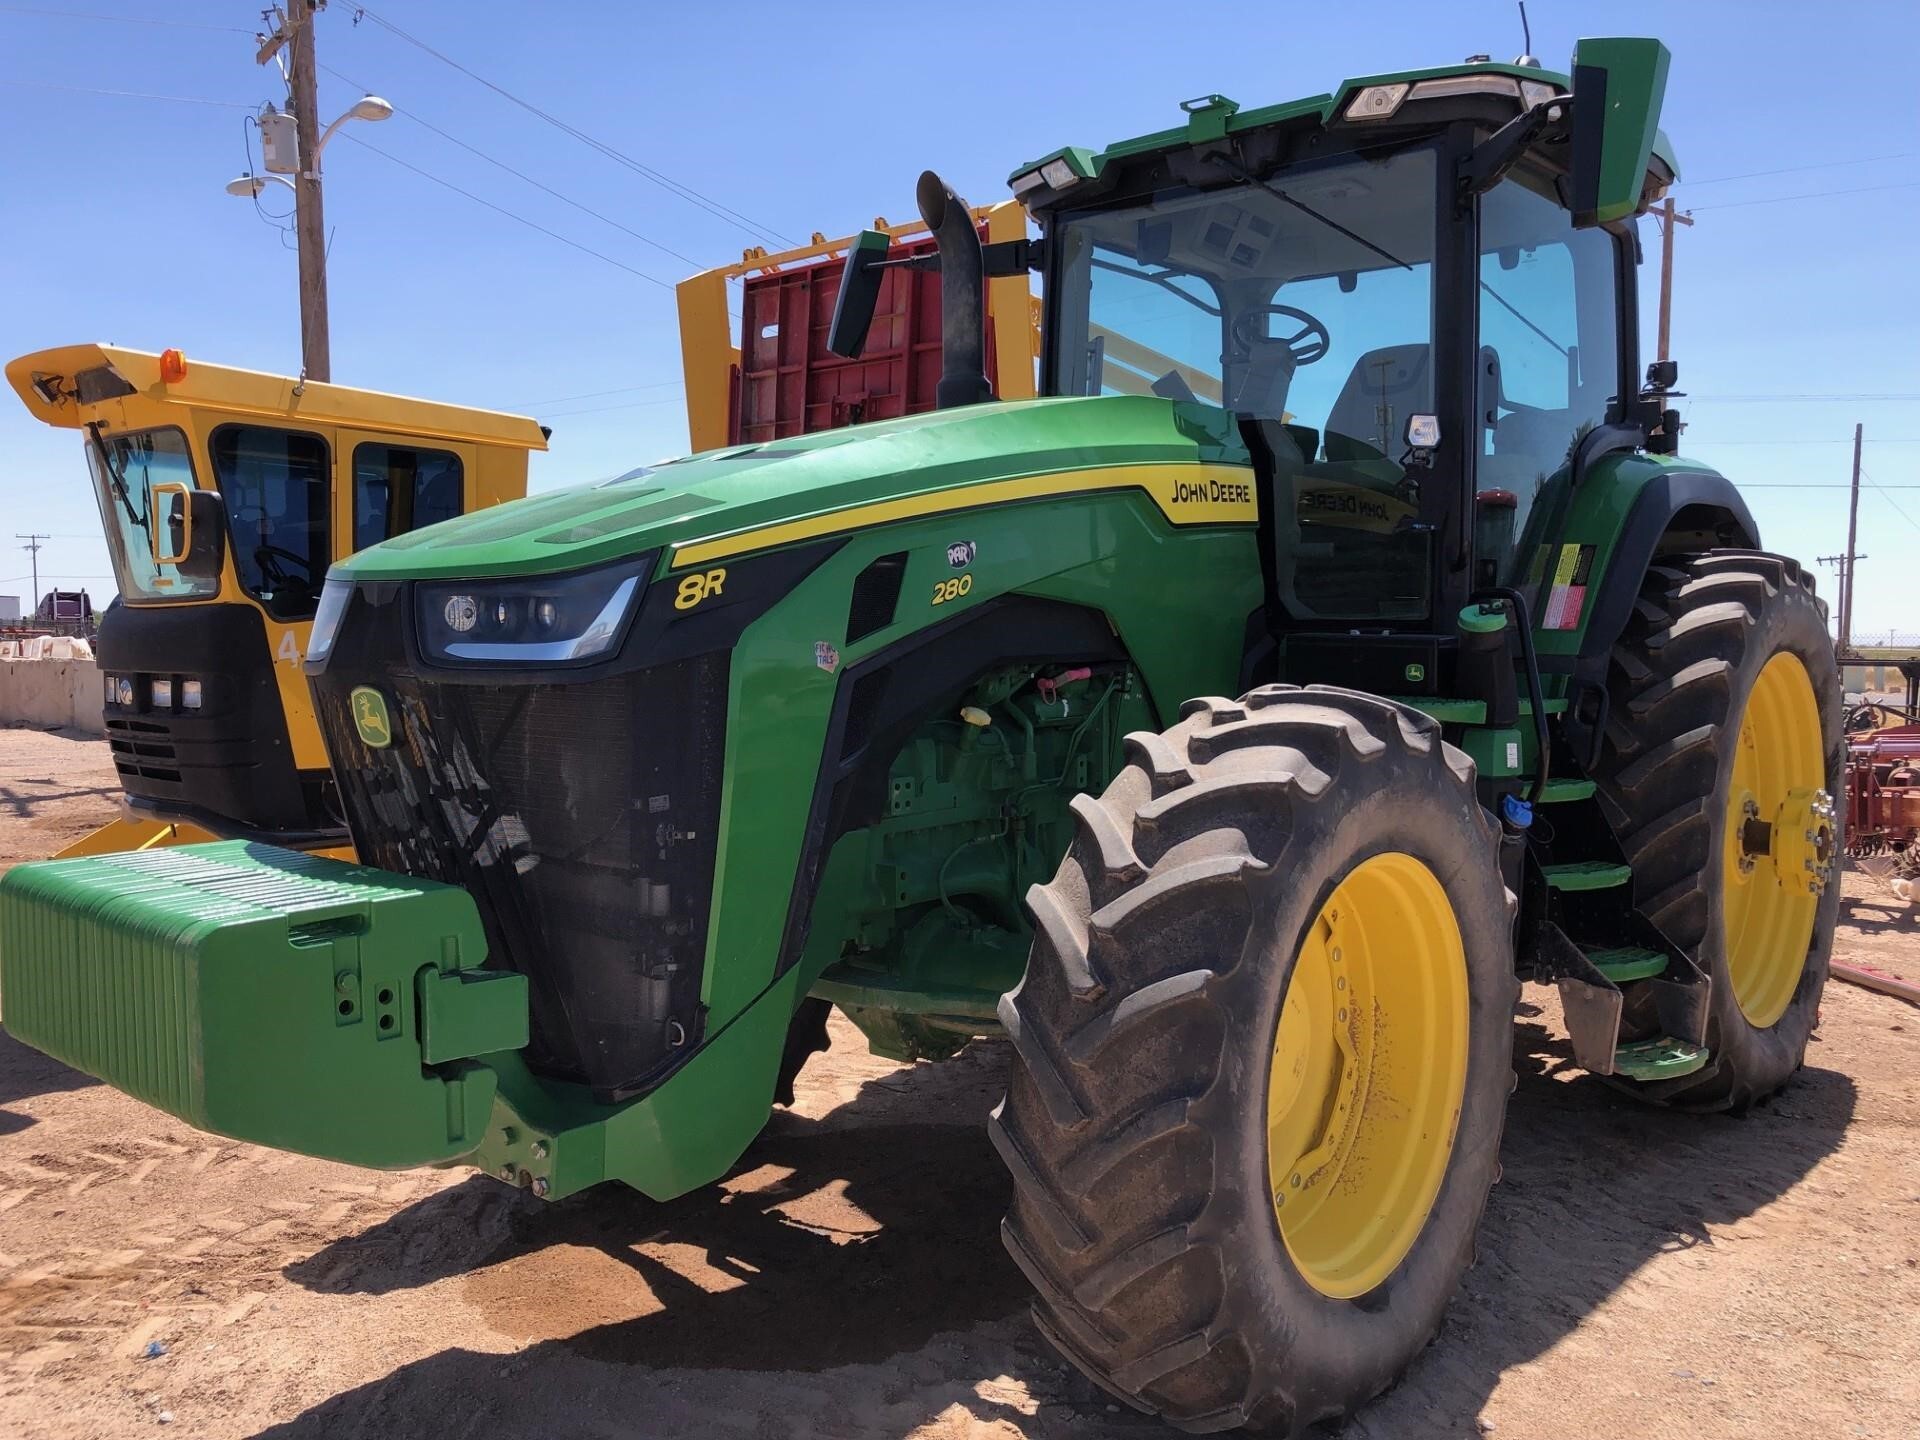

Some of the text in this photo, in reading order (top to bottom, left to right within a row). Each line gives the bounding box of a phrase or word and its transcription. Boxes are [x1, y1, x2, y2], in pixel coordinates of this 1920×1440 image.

[1172, 479, 1251, 503] JOHN DEERE
[674, 568, 726, 610] 8R
[931, 573, 973, 606] 280
[278, 630, 301, 667] 4
